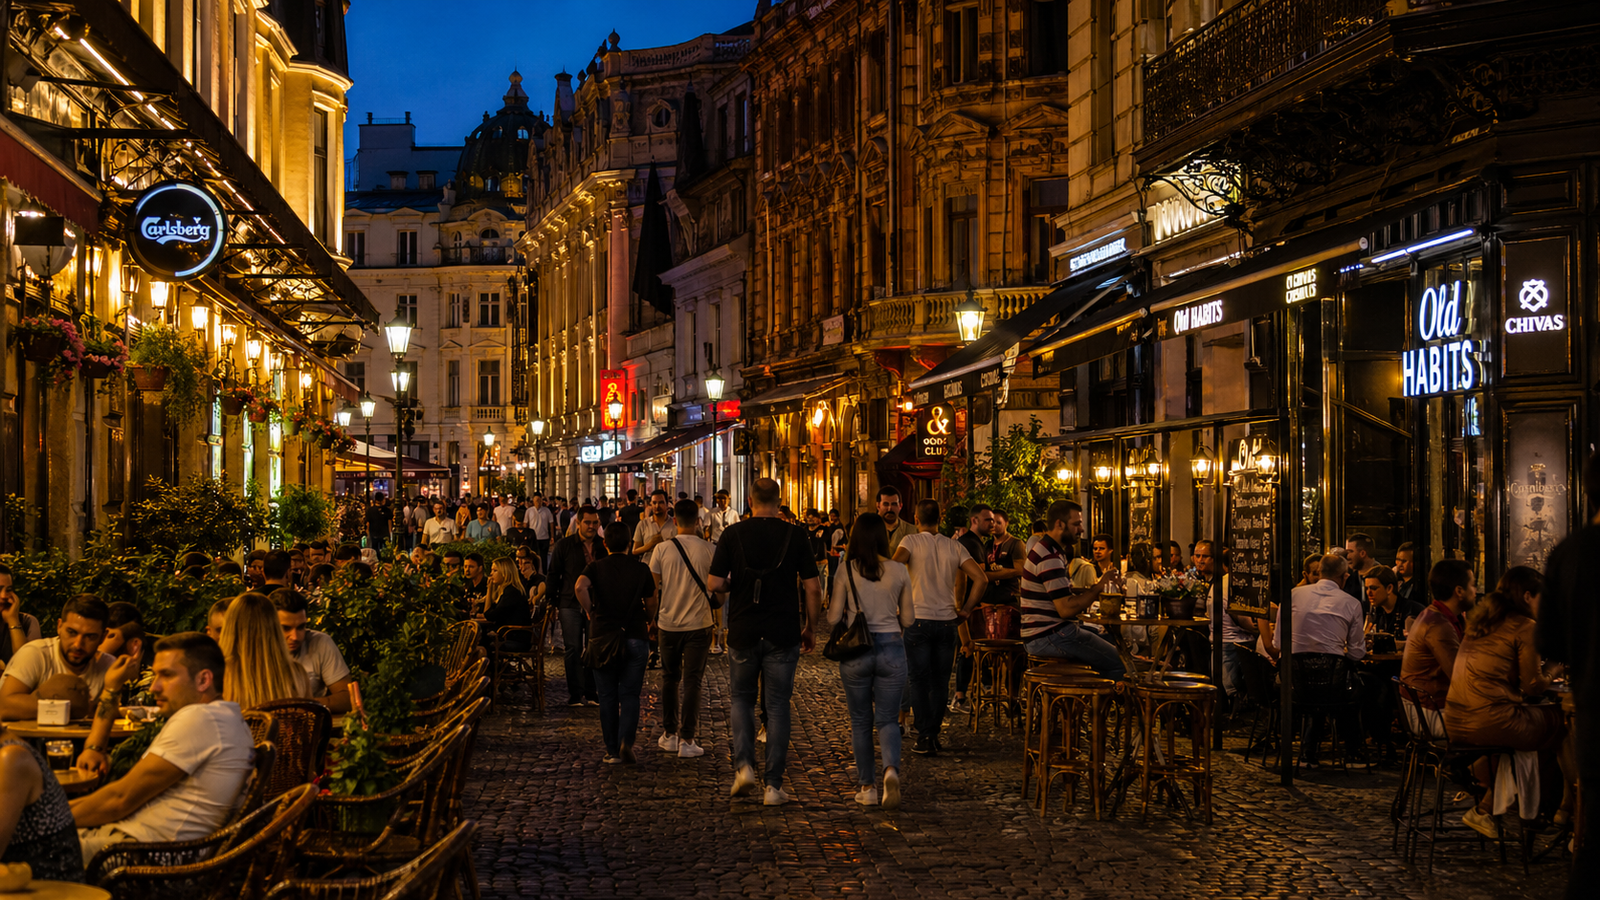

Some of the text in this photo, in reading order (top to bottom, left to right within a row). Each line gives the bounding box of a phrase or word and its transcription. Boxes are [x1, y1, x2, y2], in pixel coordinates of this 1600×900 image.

[141, 216, 211, 245] Carlsberg
[1190, 299, 1223, 329] HABITS
[1419, 280, 1461, 341] Old
[1505, 314, 1565, 334] CHIVAS
[1402, 339, 1474, 397] HABITS
